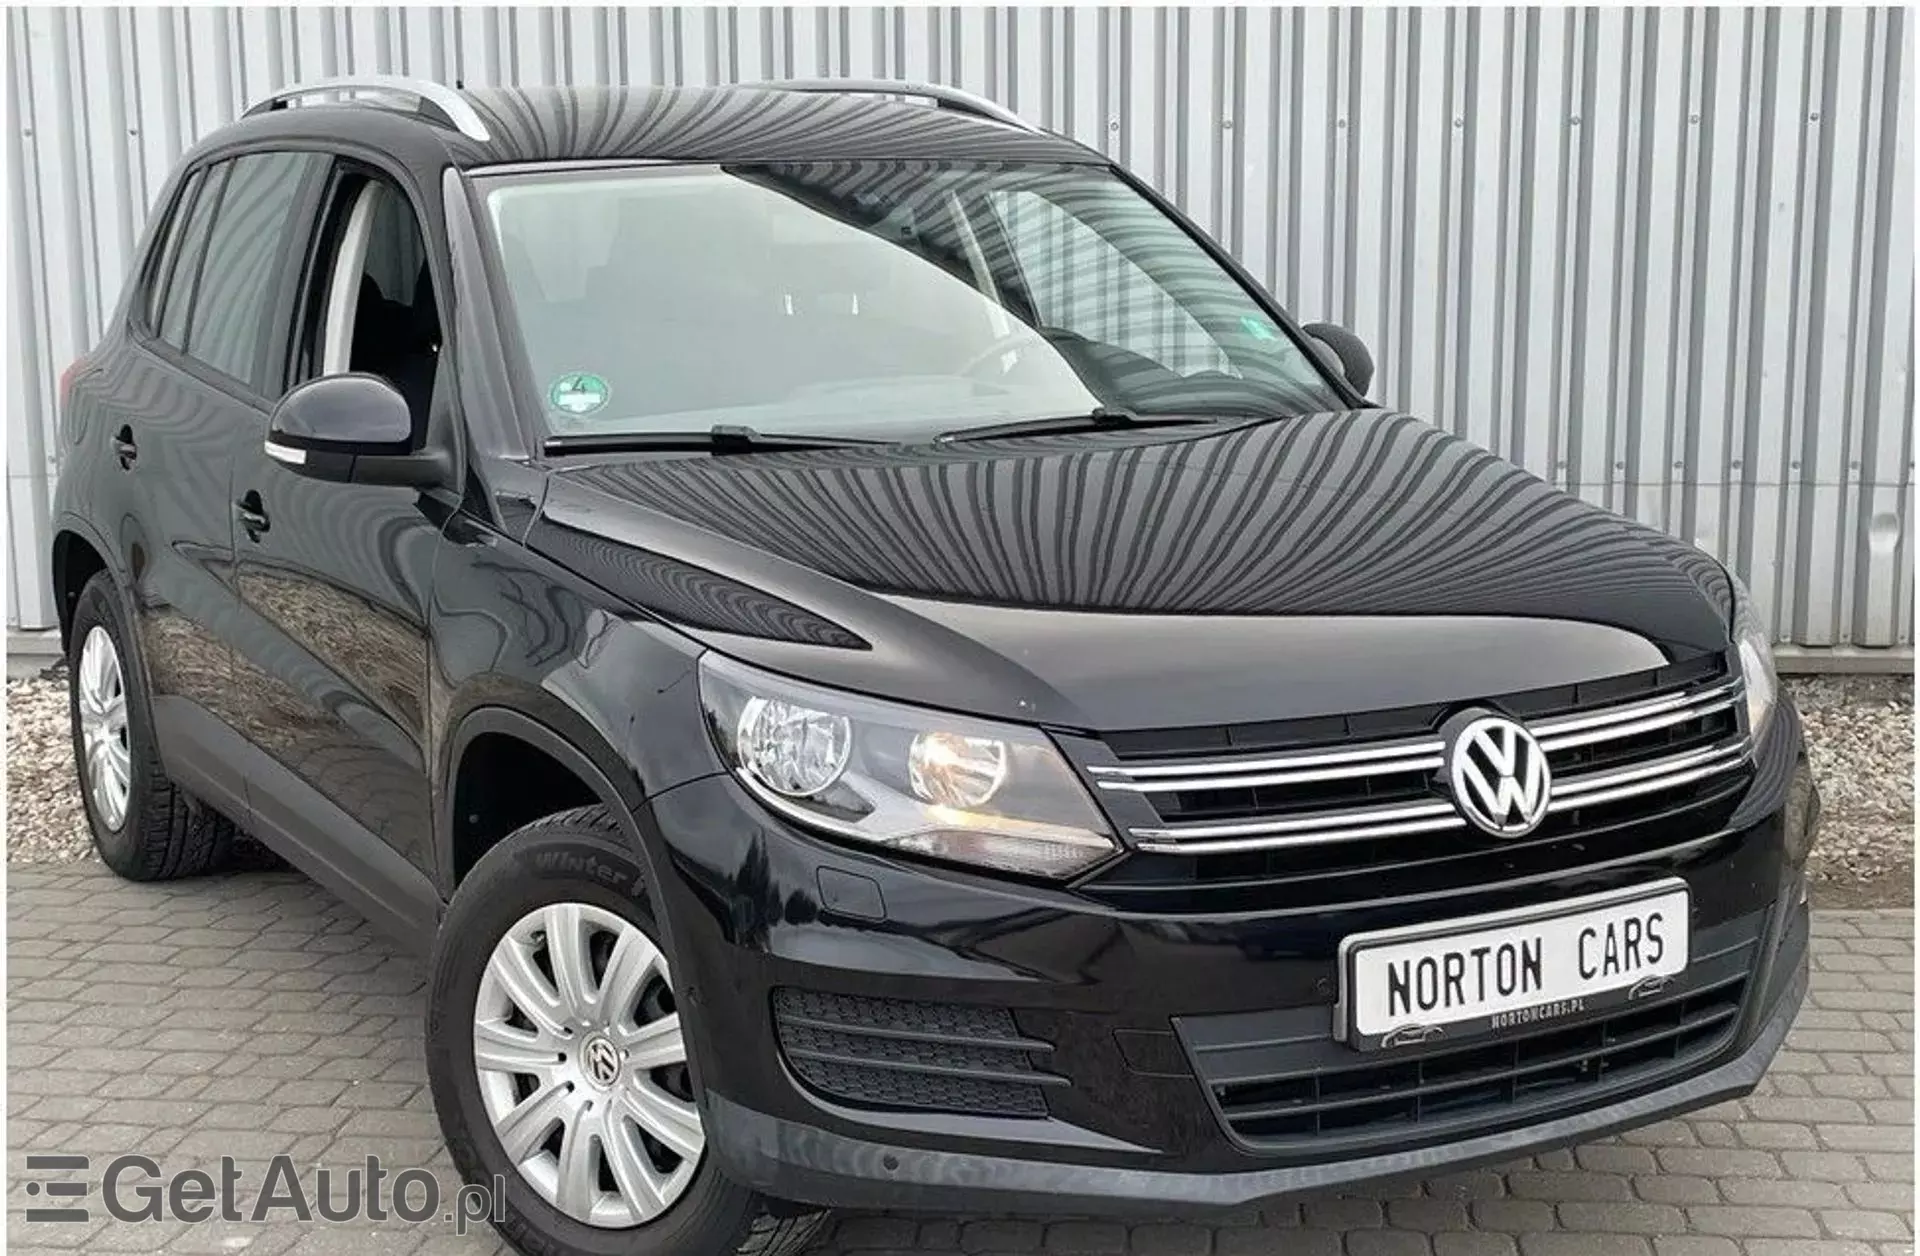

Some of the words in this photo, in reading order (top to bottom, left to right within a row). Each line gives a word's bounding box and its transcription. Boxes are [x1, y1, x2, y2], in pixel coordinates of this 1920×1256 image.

[571, 375, 586, 394] 4
[1454, 718, 1550, 836] VW
[534, 851, 628, 884] Winter
[1387, 936, 1543, 1017] NORTON
[1577, 911, 1664, 981] CARS
[1491, 998, 1585, 1029] NORTONCARS.PL
